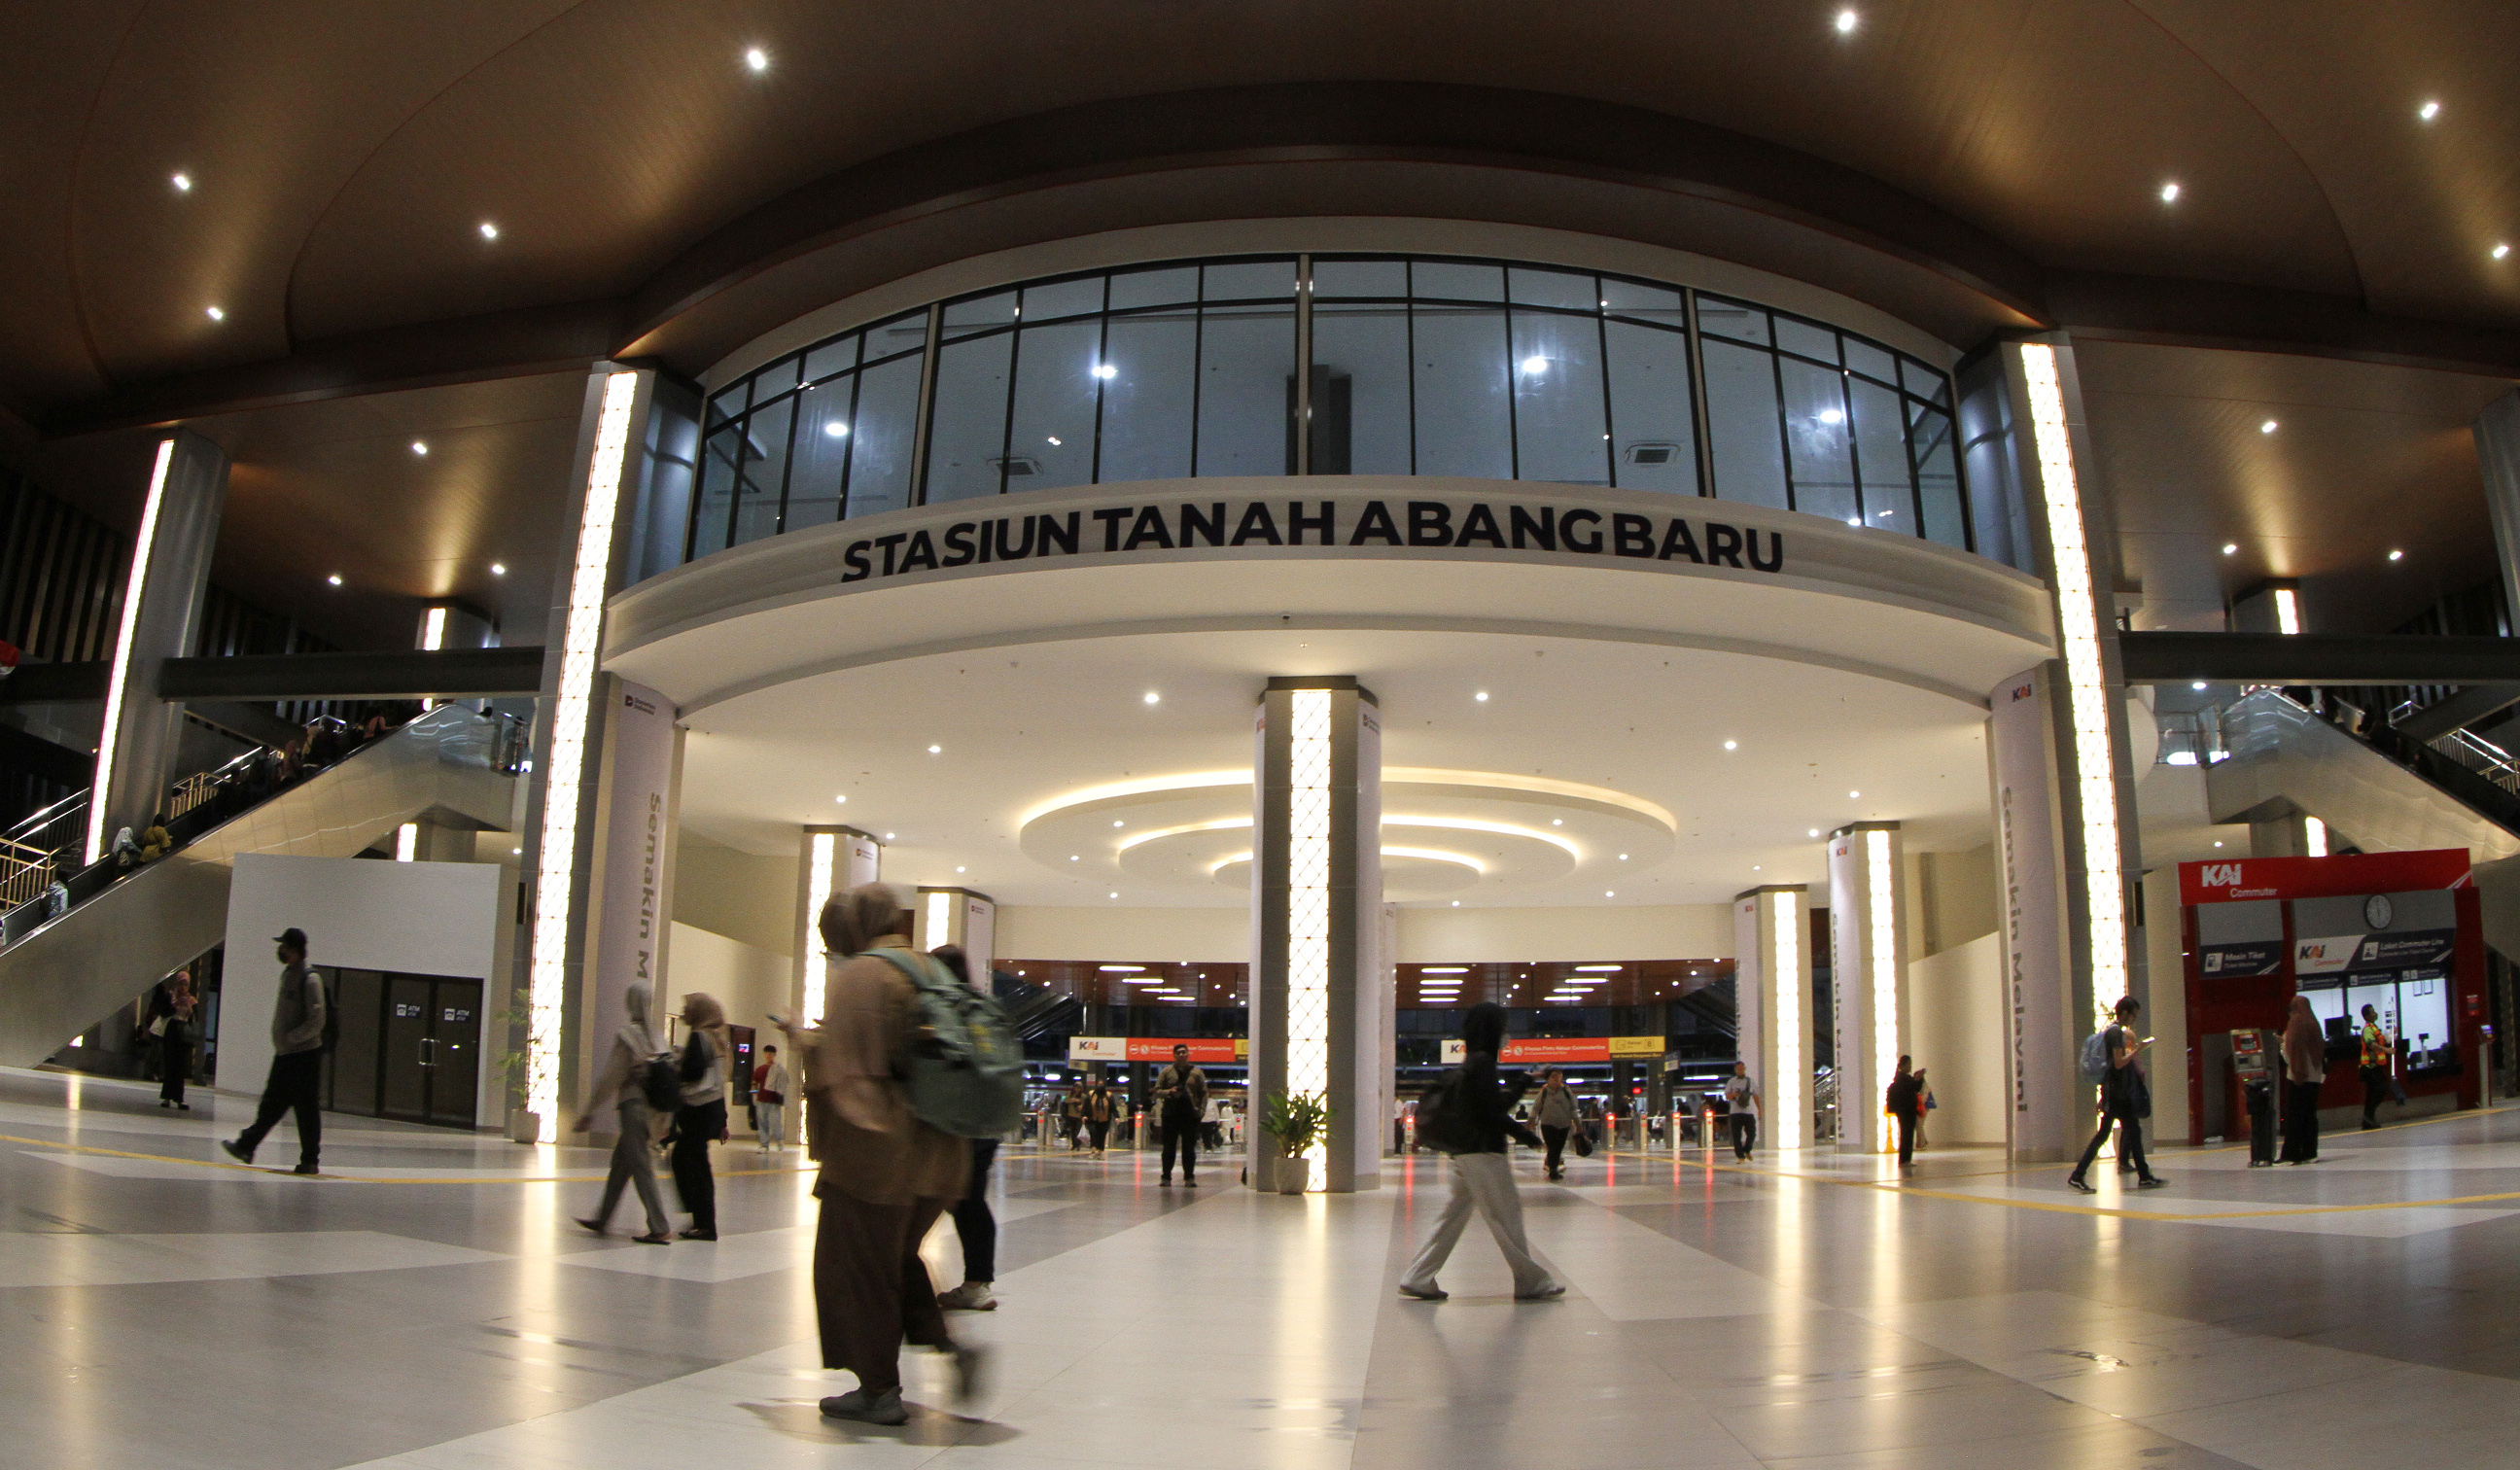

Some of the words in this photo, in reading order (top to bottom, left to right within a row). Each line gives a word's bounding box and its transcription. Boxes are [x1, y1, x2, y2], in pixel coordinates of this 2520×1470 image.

[841, 511, 1080, 583] STASIUN
[1092, 501, 1335, 552] TANAH
[640, 792, 661, 939] Semakin
[2003, 787, 2021, 941] Semakin
[2202, 863, 2242, 887] KAI
[2230, 888, 2277, 897] Commuter
